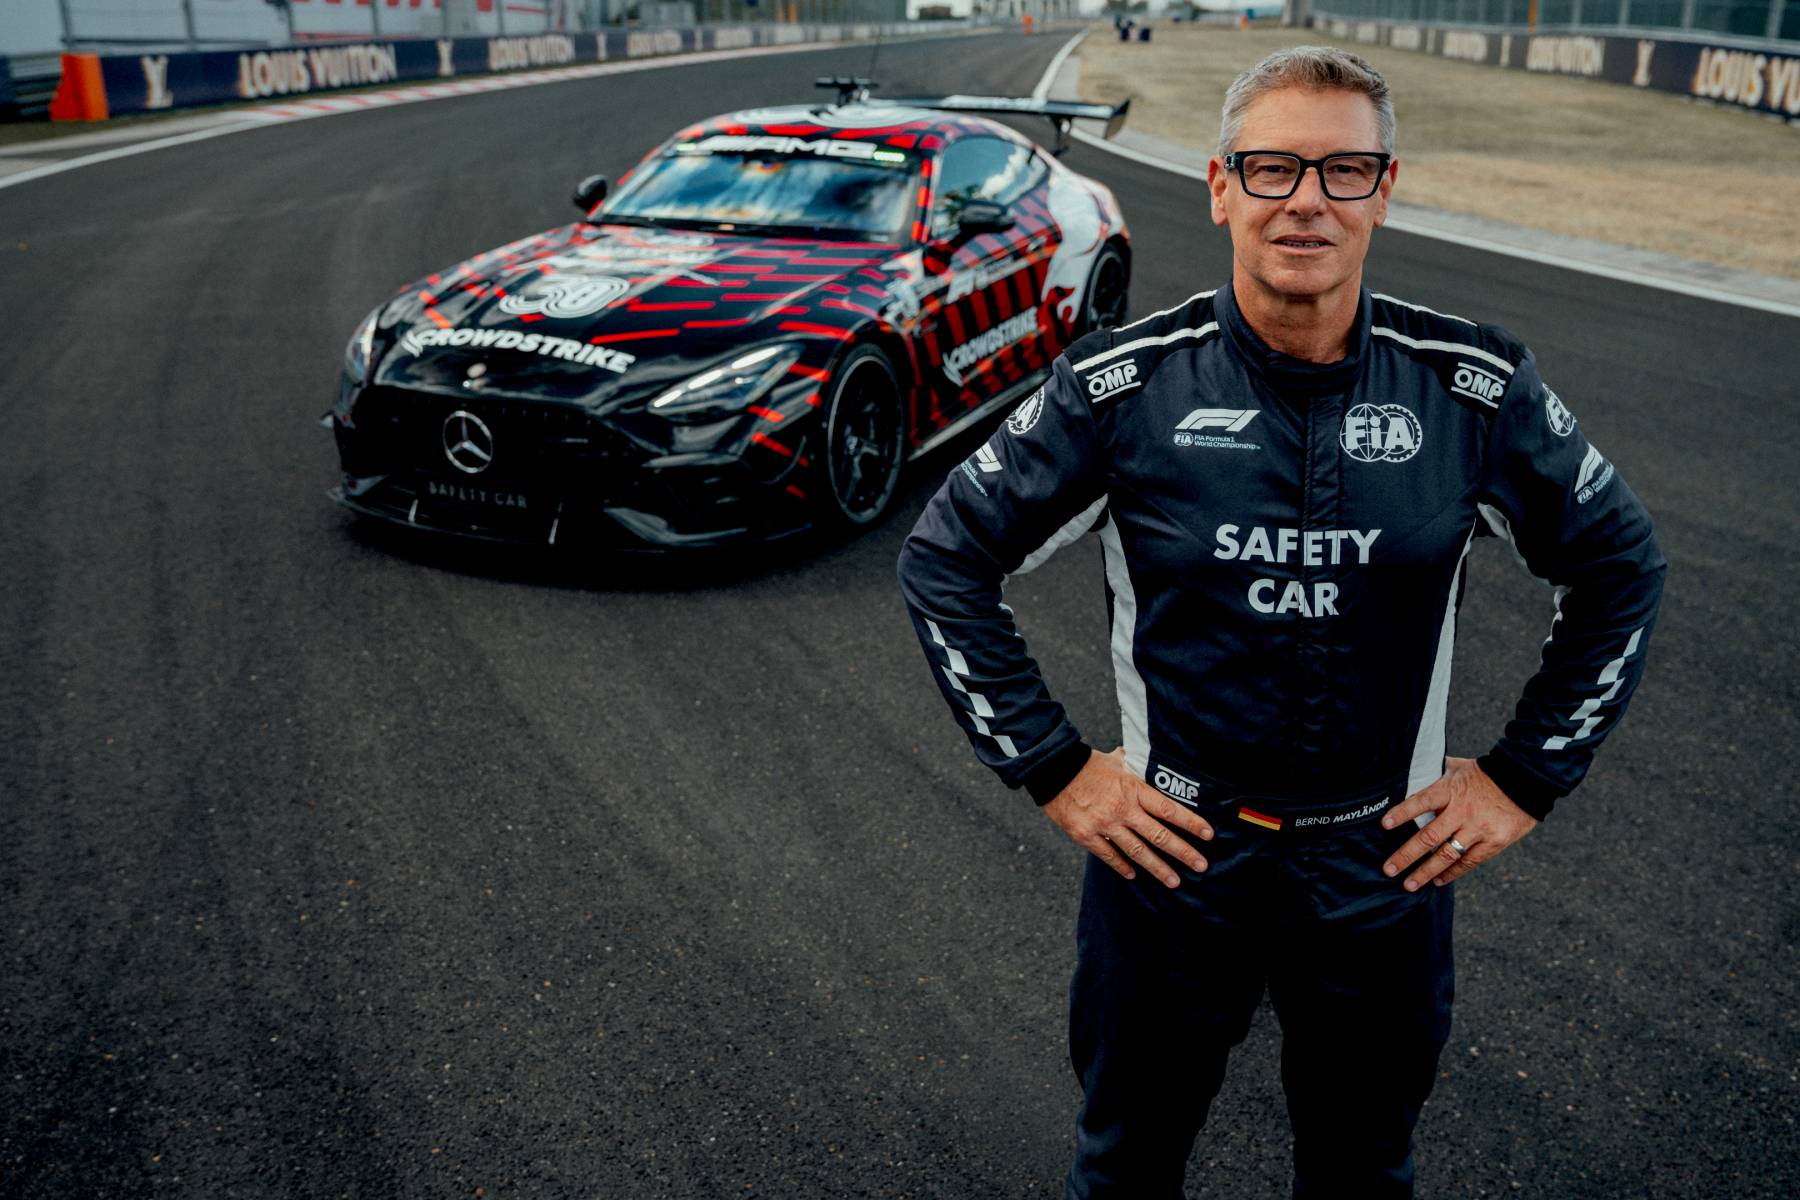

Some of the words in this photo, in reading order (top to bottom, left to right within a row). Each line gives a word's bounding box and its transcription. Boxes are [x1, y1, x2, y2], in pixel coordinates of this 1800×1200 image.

[239, 52, 310, 98] LOUIS
[310, 44, 398, 87] VUITTON
[1693, 47, 1767, 106] LOUIS
[740, 135, 877, 160] AMG
[411, 328, 636, 374] CROWDSTRIKE
[1088, 364, 1138, 396] OMP
[1454, 368, 1504, 400] OMP
[494, 493, 527, 508] CAR
[1214, 523, 1382, 566] SAFETY
[1248, 578, 1340, 618] CAR
[1154, 771, 1199, 801] OMP
[1295, 816, 1330, 827] BERND
